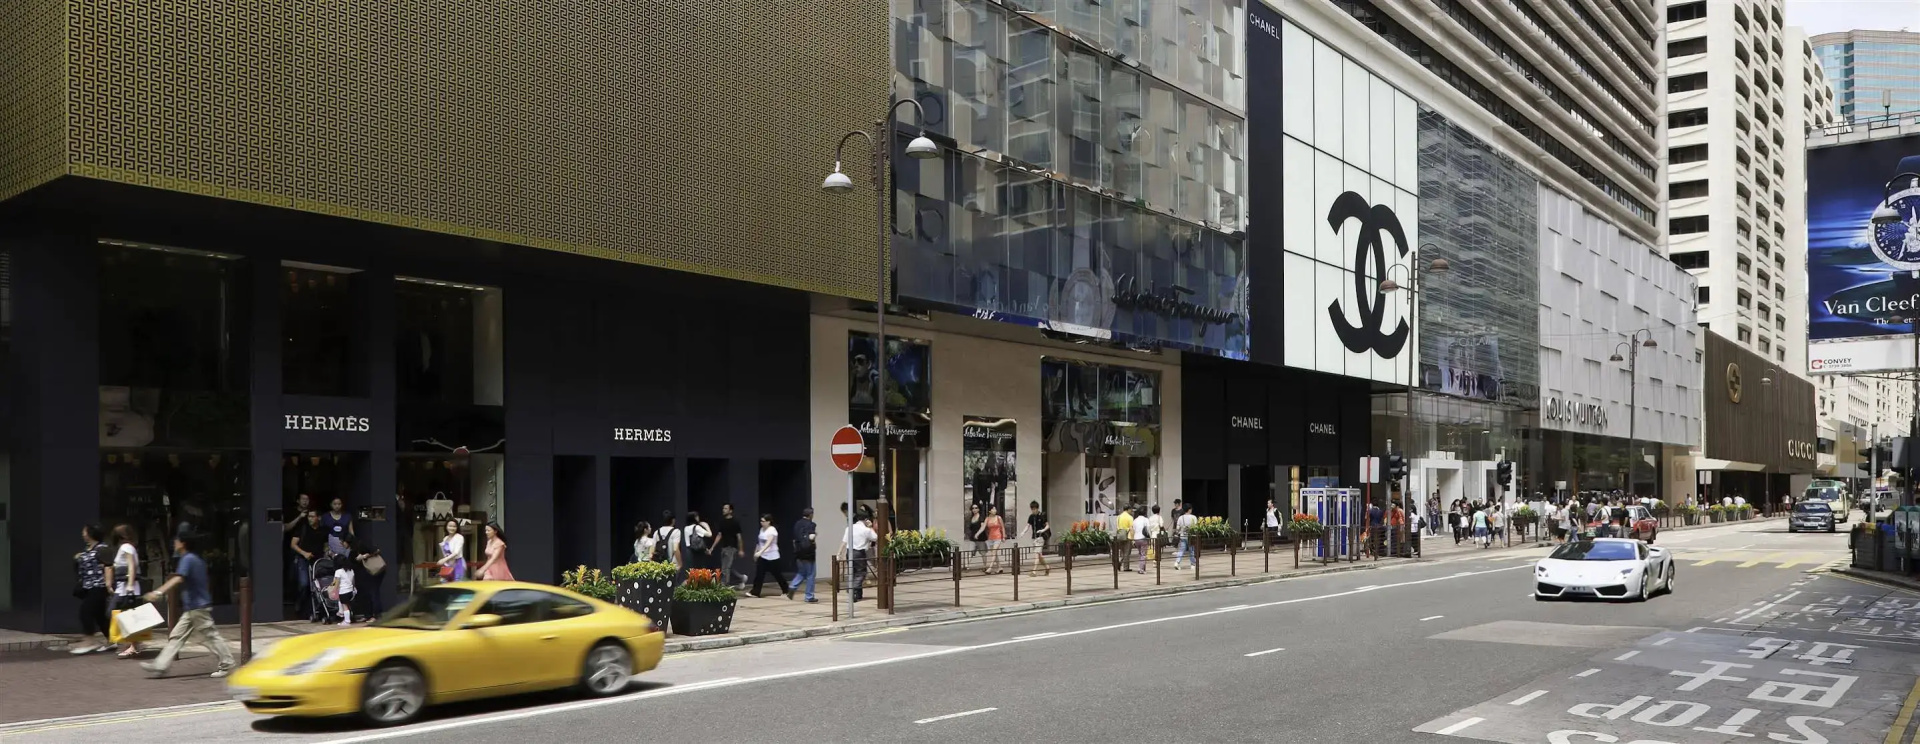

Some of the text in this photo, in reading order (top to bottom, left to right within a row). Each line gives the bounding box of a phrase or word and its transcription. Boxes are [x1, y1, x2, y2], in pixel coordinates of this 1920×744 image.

[1250, 13, 1280, 40] CHANEL
[1823, 293, 1920, 315] Van Cleef
[1231, 416, 1263, 430] CHANEL
[1543, 397, 1608, 428] LOUIS VUITTON
[1309, 422, 1336, 435] CHANEL
[1788, 439, 1815, 460] GUCCI
[1566, 694, 1845, 744] STOP
